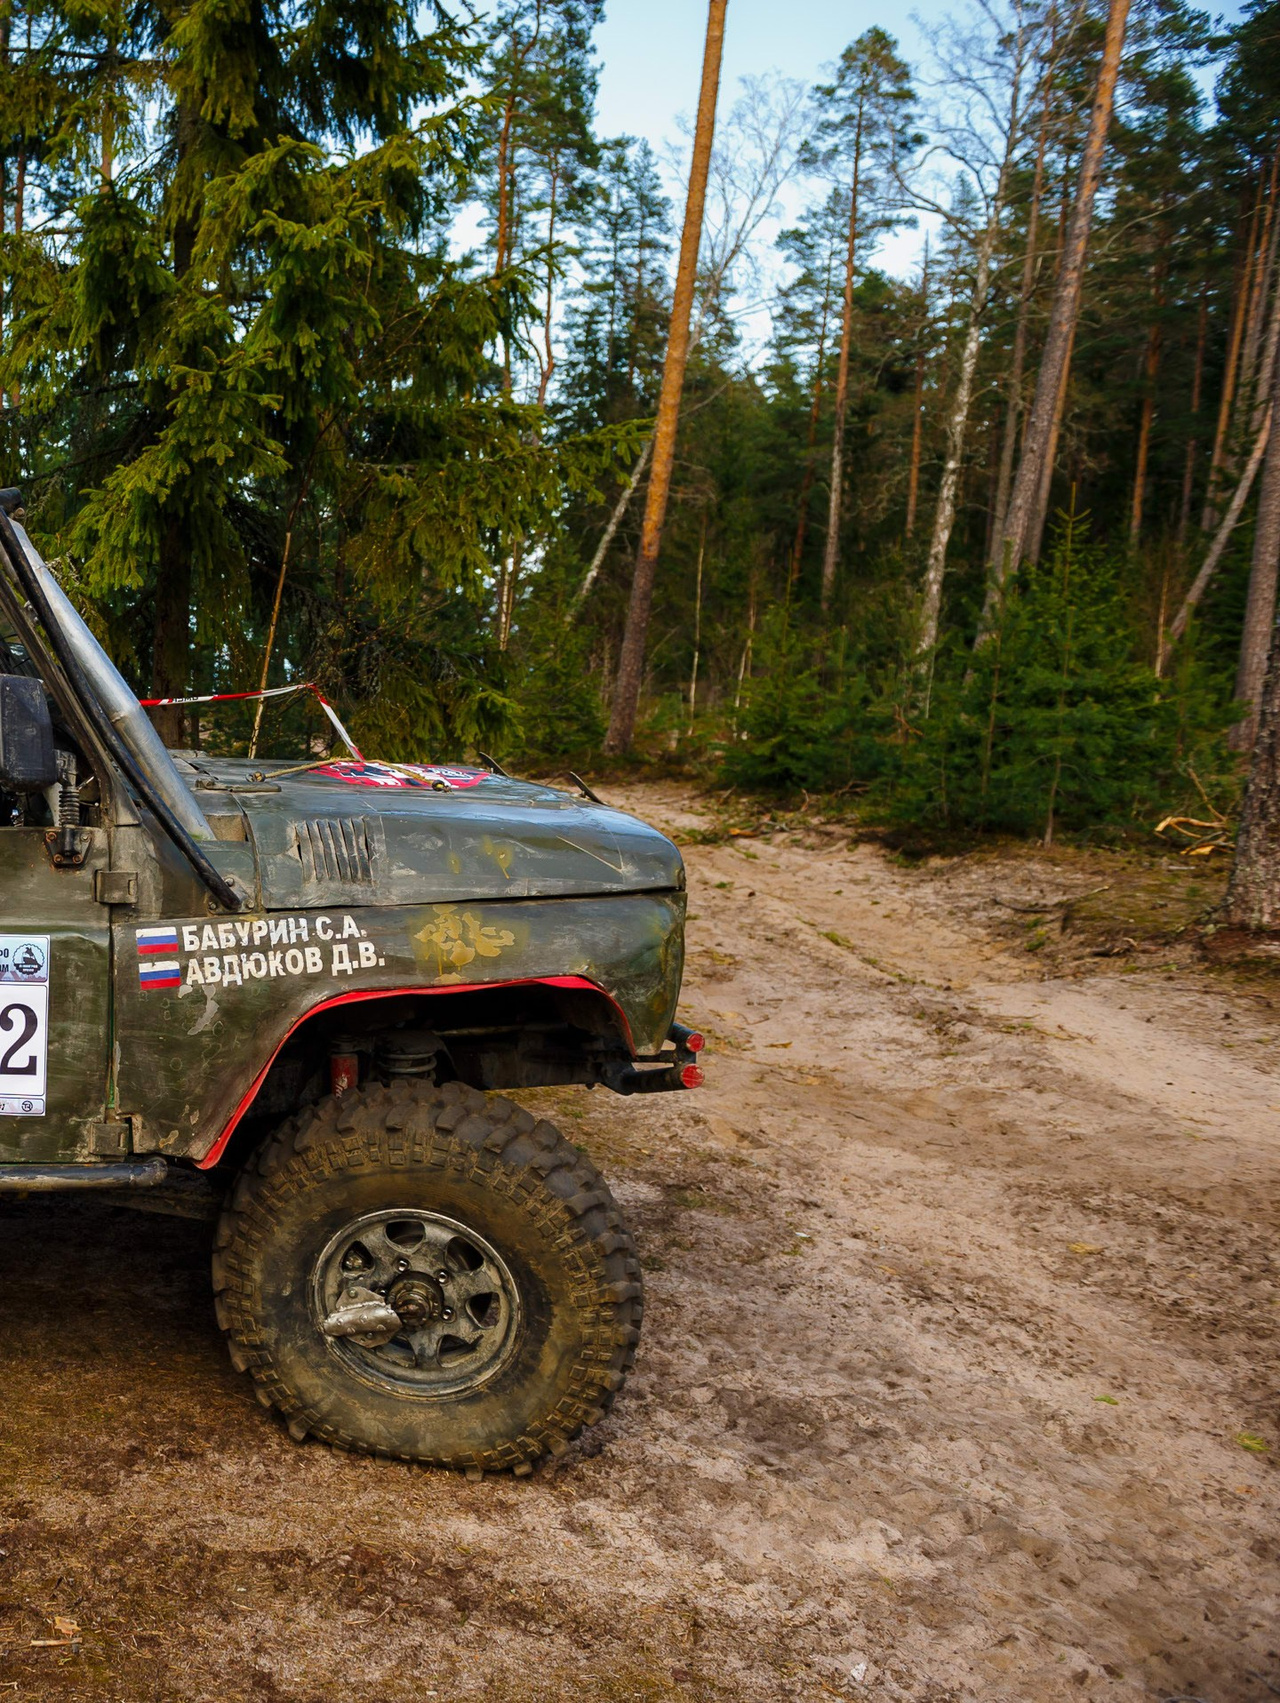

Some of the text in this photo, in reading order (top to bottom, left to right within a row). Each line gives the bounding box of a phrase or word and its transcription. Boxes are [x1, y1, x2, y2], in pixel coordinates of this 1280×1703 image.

[182, 914, 367, 951] БАБУРИН С.А.
[186, 941, 386, 987] АВДЮКОВ Д.В.
